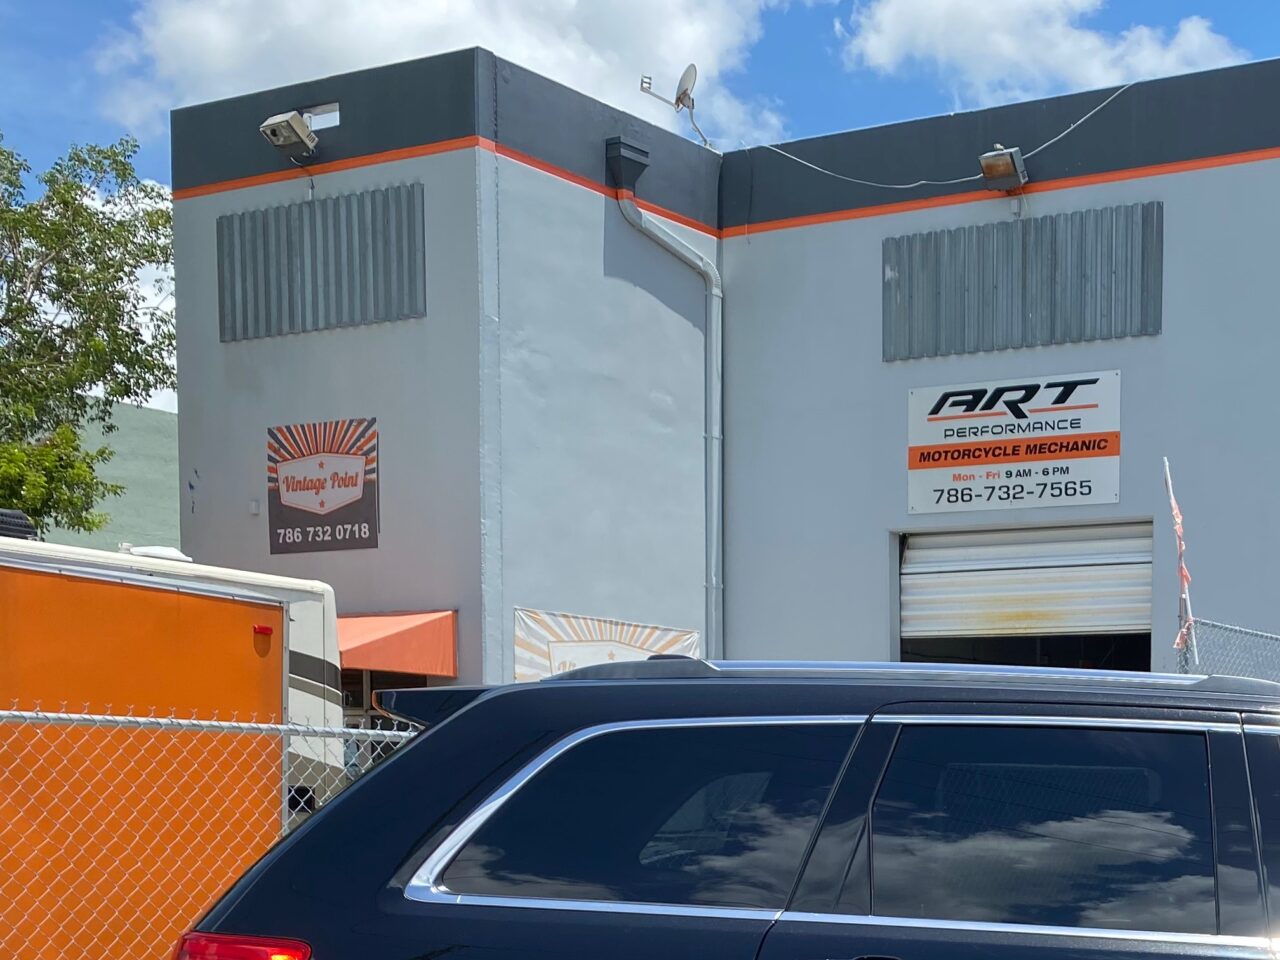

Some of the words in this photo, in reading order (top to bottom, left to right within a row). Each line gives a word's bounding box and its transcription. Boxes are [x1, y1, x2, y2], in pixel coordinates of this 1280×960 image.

[927, 378, 1100, 420] ART
[944, 418, 1082, 439] PERFORMANCE
[919, 445, 1021, 463] MOTORCYCLE
[1025, 438, 1109, 456] MECHANIC
[282, 475, 327, 495] Vintage
[330, 471, 359, 489] Point
[952, 473, 976, 482] Mon
[986, 470, 1001, 480] Fri
[1005, 470, 1013, 479] 9
[1015, 468, 1032, 478] AM
[1042, 467, 1050, 476] 6
[1052, 466, 1070, 476] PM
[933, 480, 1093, 504] 786-732-7565
[277, 528, 302, 544] 786
[306, 526, 332, 542] 732
[336, 523, 370, 540] 0718
